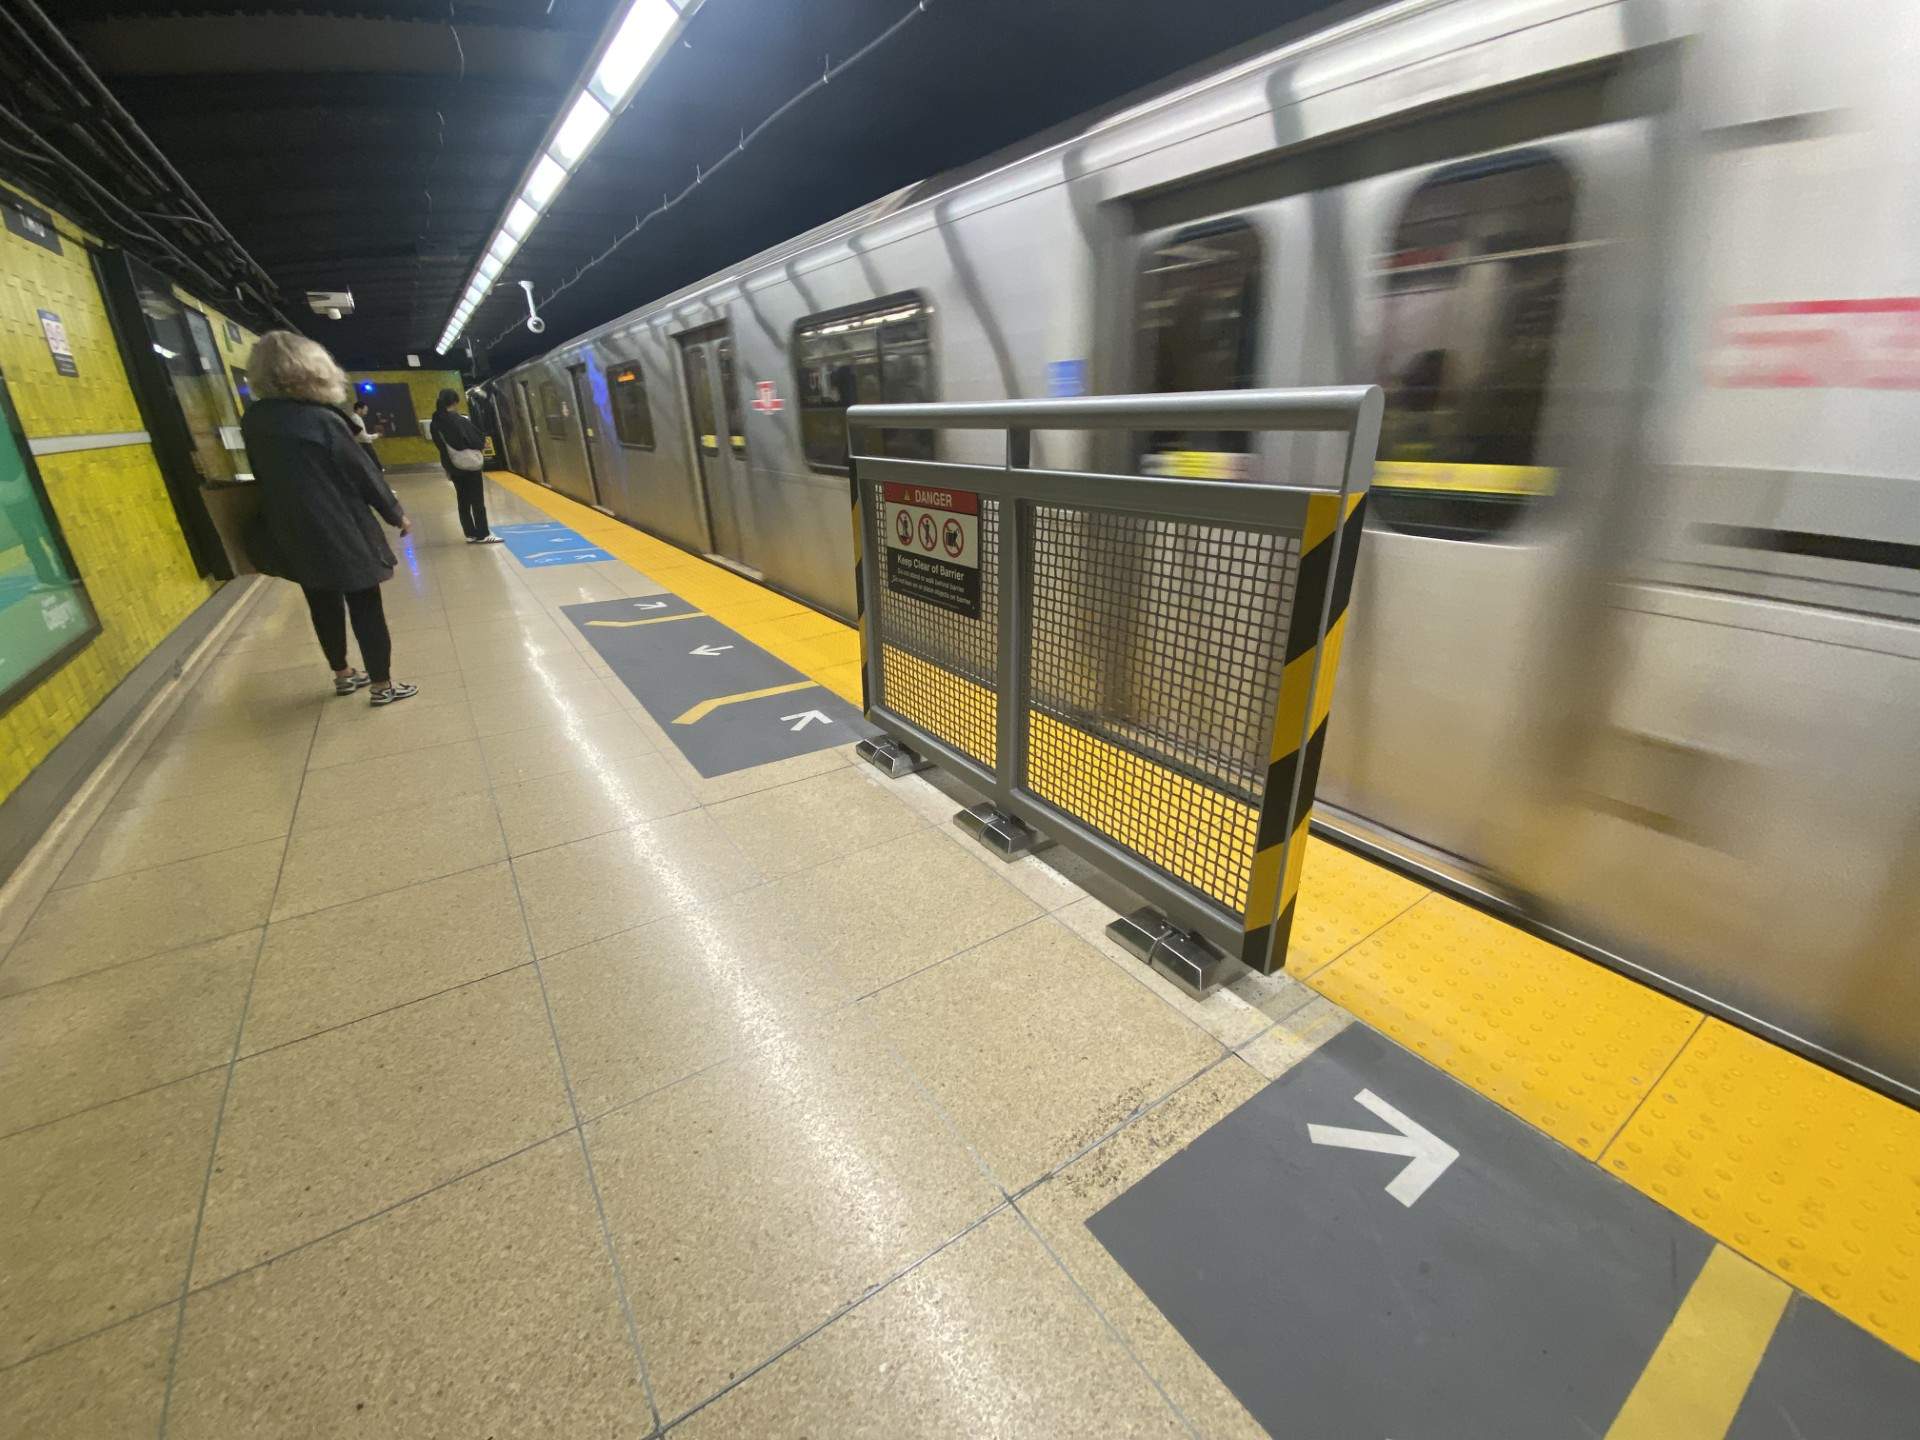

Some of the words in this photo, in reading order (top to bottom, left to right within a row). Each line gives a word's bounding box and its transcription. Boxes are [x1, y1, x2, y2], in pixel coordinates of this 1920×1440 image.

[915, 490, 952, 507] DANGER
[897, 554, 912, 568] Keep
[913, 558, 930, 571] Clear
[931, 564, 939, 574] of
[940, 566, 964, 580] Barrier
